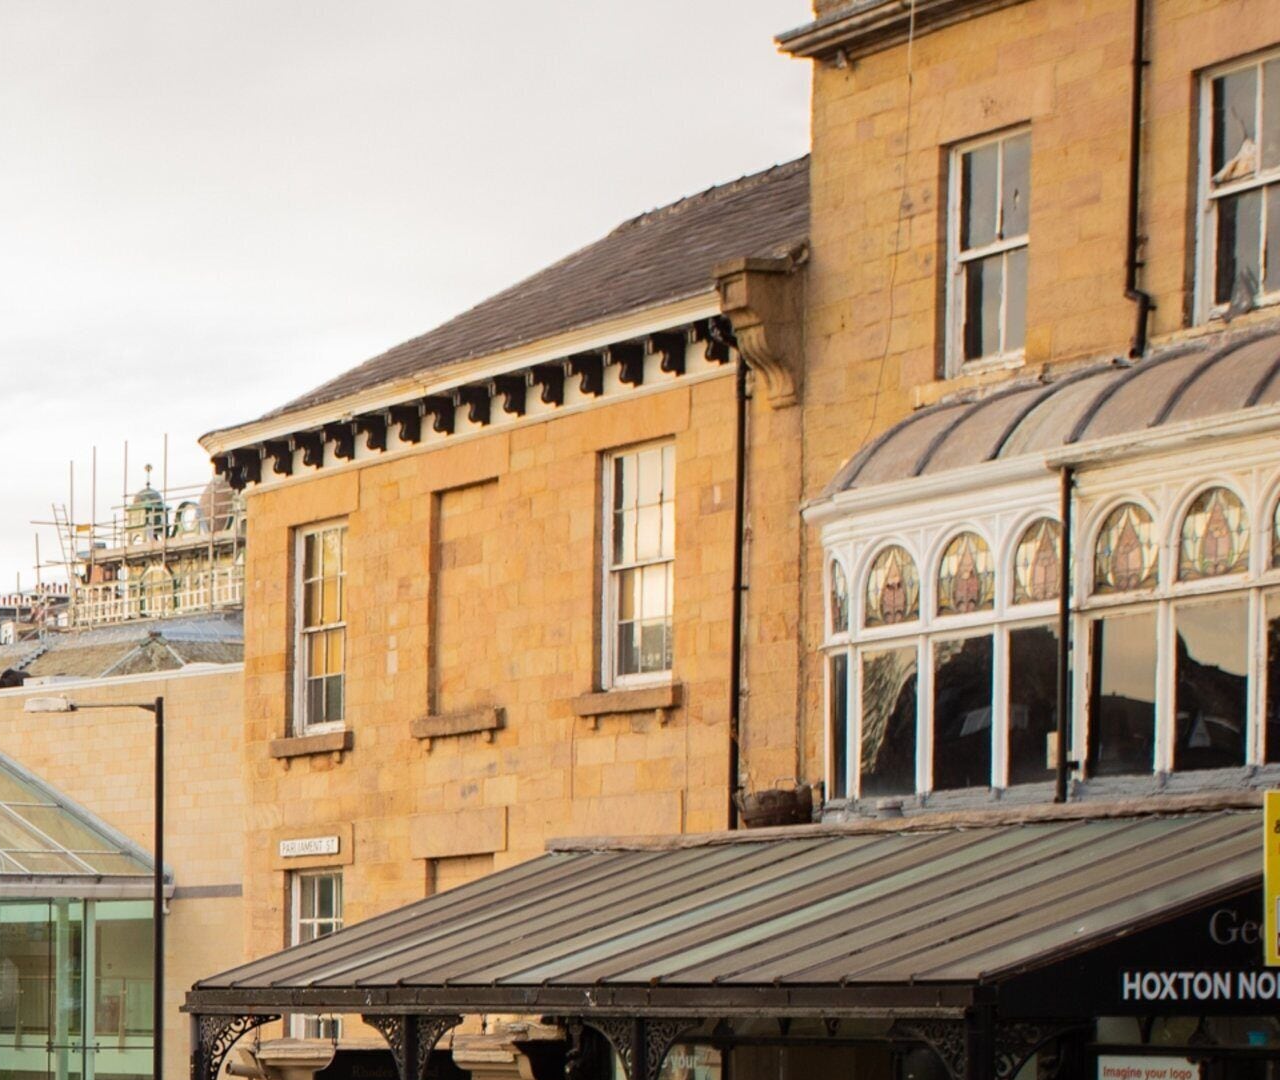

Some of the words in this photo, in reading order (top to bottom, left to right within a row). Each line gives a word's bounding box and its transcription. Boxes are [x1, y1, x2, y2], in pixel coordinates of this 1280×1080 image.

[1122, 970, 1231, 1001] HOXTON
[1103, 1067, 1142, 1080] Imagine
[1144, 1069, 1167, 1080] your
